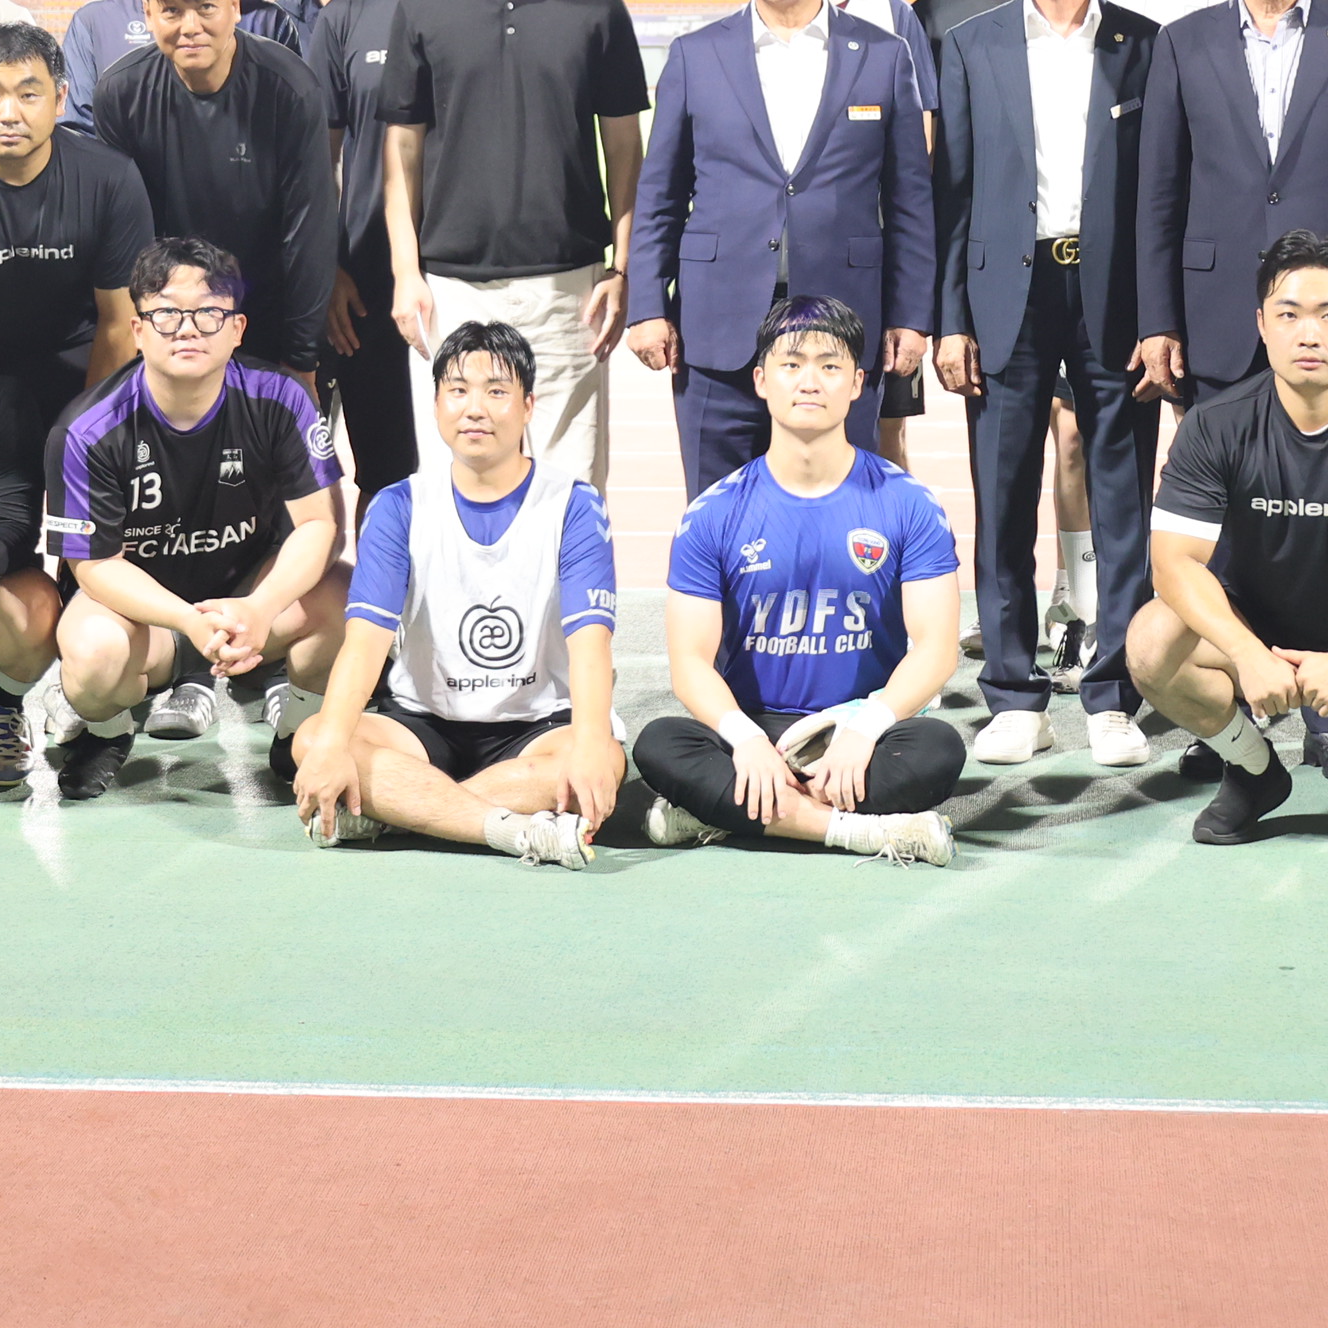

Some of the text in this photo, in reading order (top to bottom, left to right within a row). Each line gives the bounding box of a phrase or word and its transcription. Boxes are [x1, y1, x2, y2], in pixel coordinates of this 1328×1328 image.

[130, 471, 163, 512] 13
[124, 524, 163, 538] SINCE
[122, 539, 159, 559] FC
[751, 588, 872, 636] YDFS
[745, 635, 829, 657] FOOTBALL
[446, 672, 537, 692] applerind
